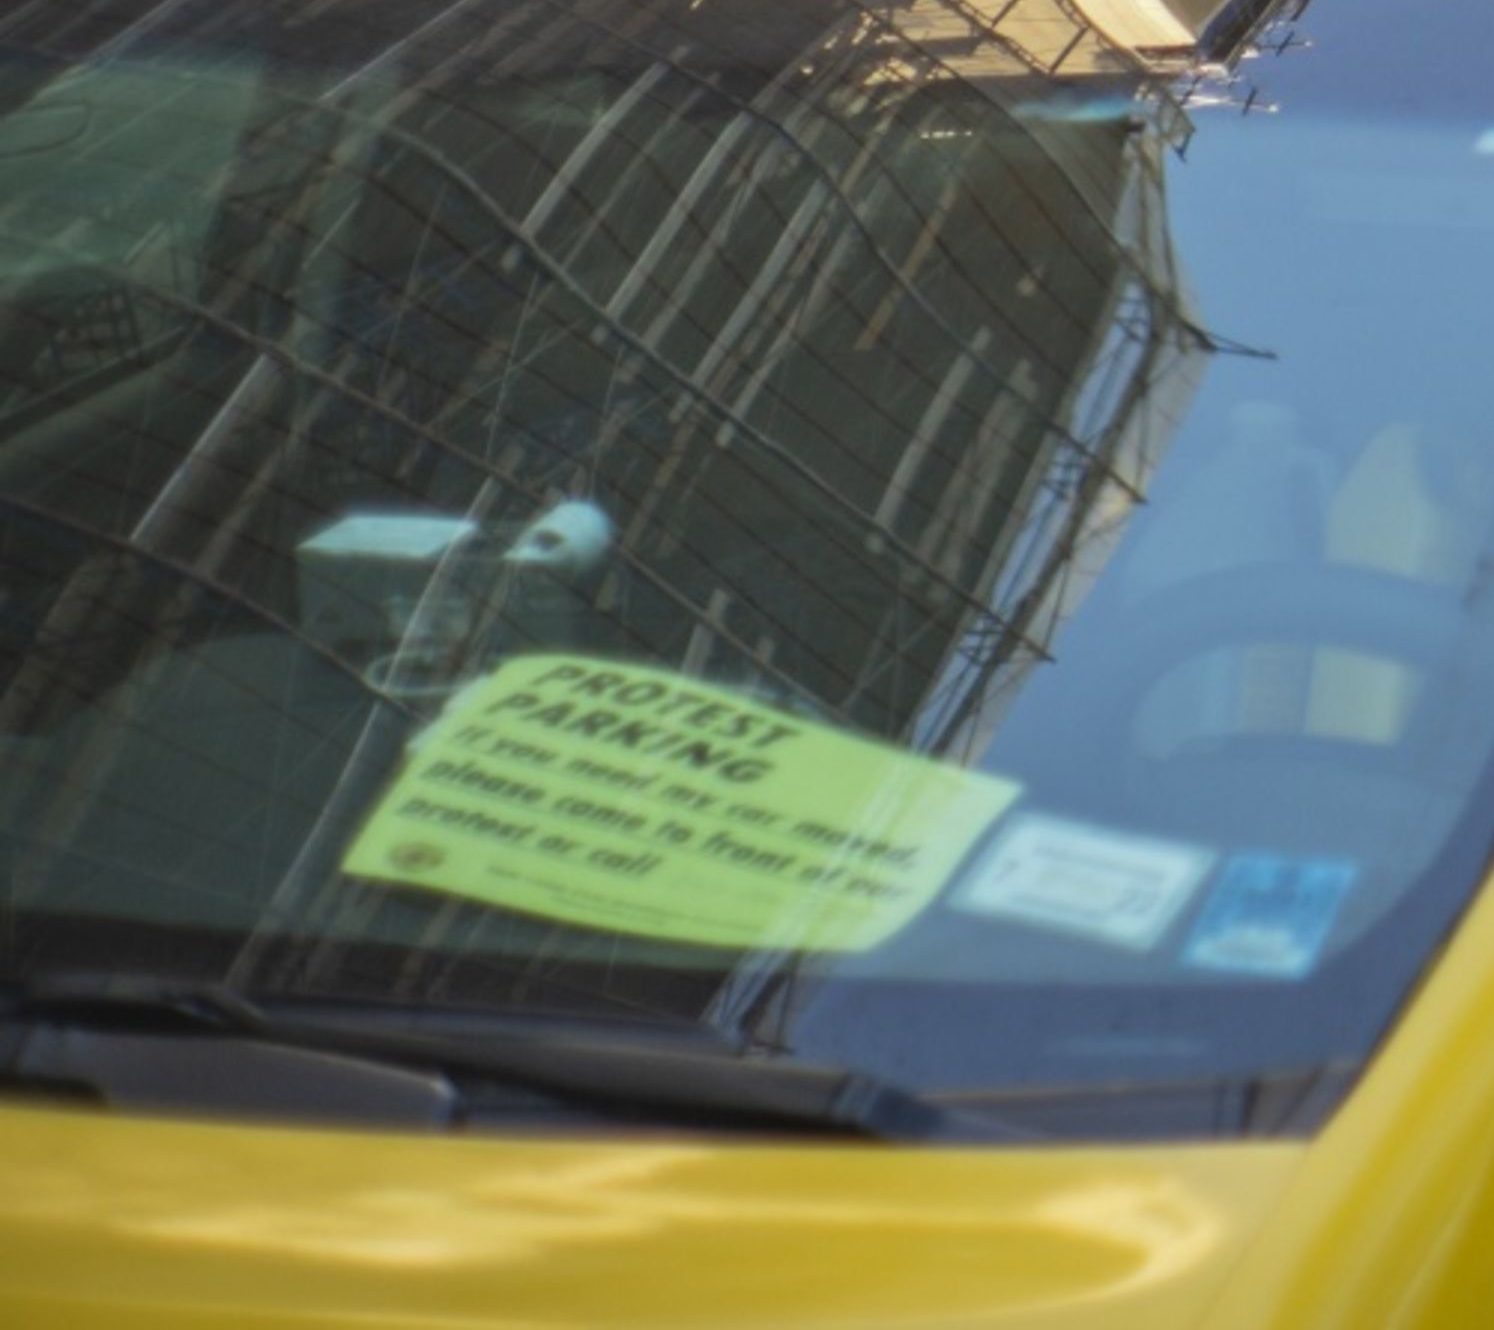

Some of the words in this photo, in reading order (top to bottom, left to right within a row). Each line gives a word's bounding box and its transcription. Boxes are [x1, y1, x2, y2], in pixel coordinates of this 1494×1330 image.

[482, 691, 774, 783] PARKING
[528, 663, 799, 750] PROTEST
[397, 798, 537, 840] protest
[417, 761, 547, 804] please
[553, 795, 647, 832] come
[656, 821, 694, 845] to
[702, 832, 797, 874] front
[563, 757, 662, 789] need
[659, 785, 717, 813] my
